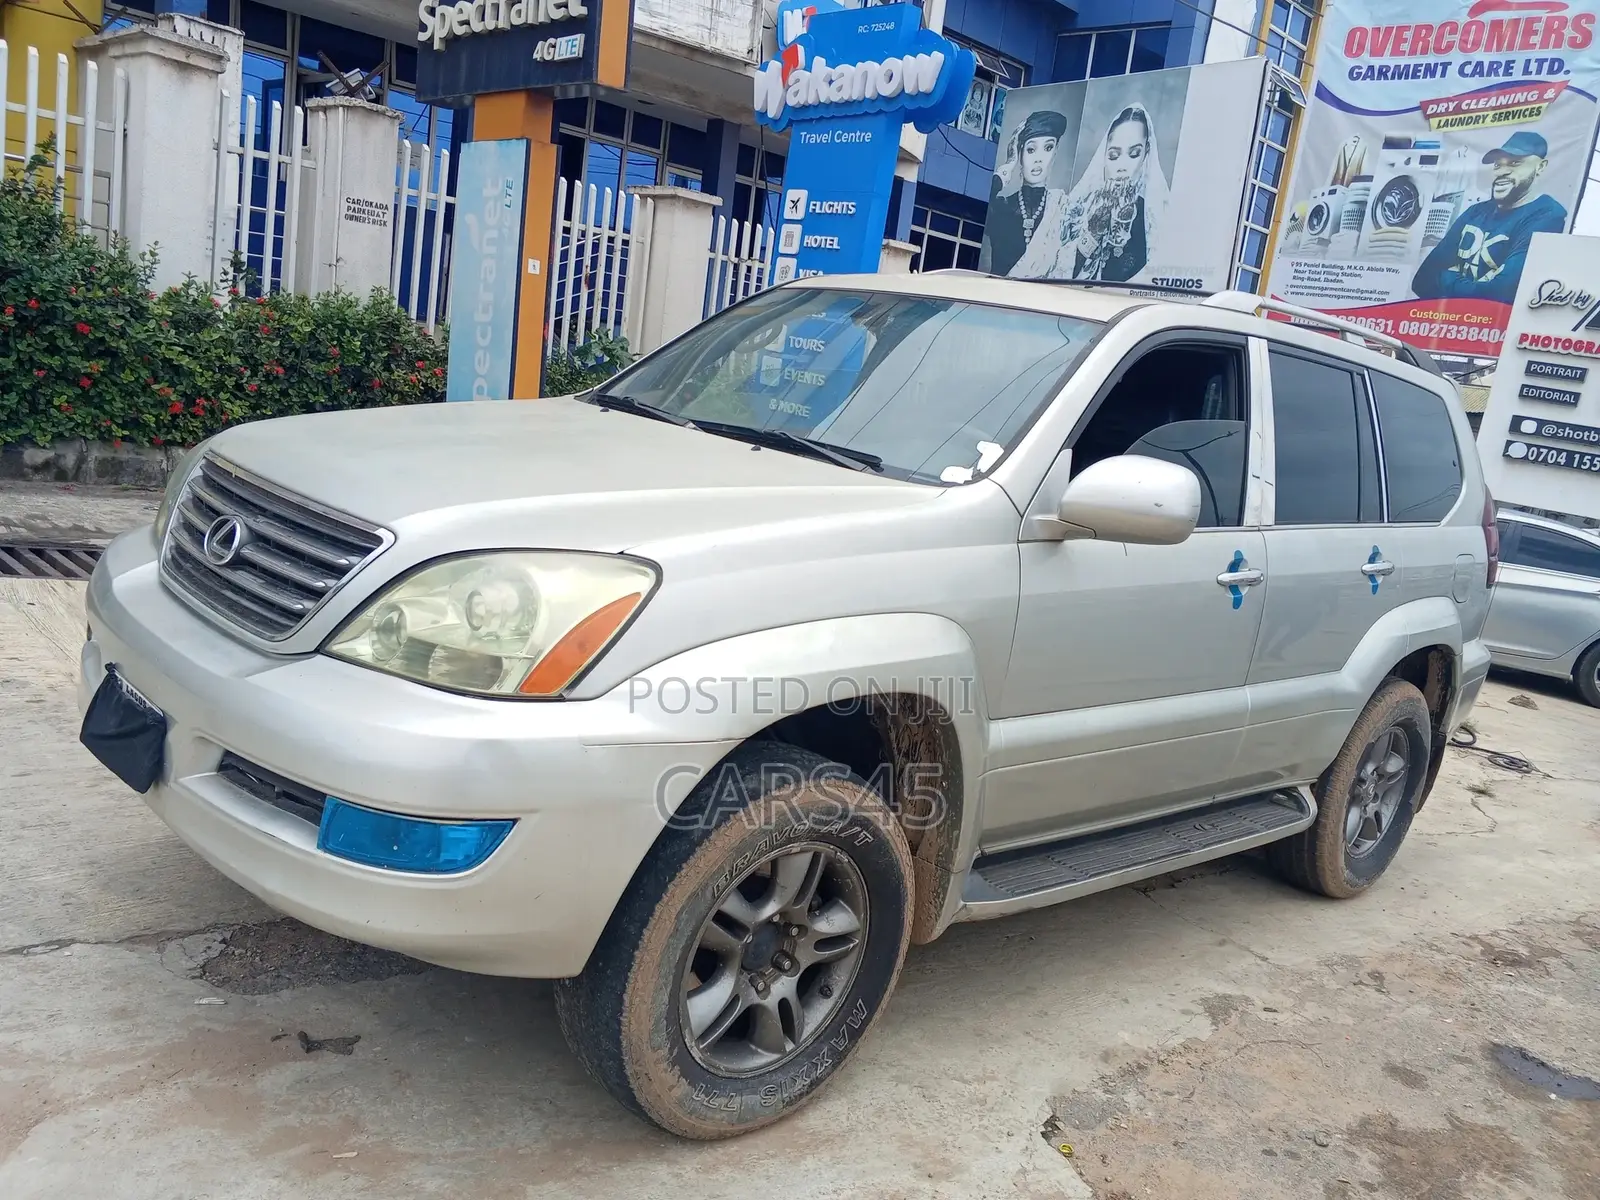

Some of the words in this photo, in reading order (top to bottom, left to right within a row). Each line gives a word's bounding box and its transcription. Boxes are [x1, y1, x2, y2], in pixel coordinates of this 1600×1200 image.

[857, 24, 870, 35] RC:
[871, 21, 895, 33] 725248
[1343, 13, 1596, 60] OVERCOMERS
[533, 37, 556, 61] 4G
[556, 36, 580, 58] LTE
[1348, 61, 1452, 82] GARMENT
[1457, 59, 1516, 79] CARE
[1521, 57, 1571, 77] LTD.
[754, 44, 945, 120] Wakanow
[1426, 100, 1459, 116] DRY
[1461, 90, 1540, 111] CLEANING
[1543, 87, 1556, 100] &
[1436, 113, 1489, 130] LAUNDRY
[1490, 105, 1543, 123] SERVICES
[800, 130, 831, 145] Travel
[834, 129, 872, 144] Centre
[345, 196, 389, 211] CAR/OKADA
[504, 179, 514, 209] LTE
[809, 201, 857, 215] FLIGHTS
[371, 217, 388, 227] RISK
[803, 235, 841, 249] HOTEL
[472, 175, 502, 400] pectranet
[1151, 277, 1204, 290] STUDIOS
[1409, 308, 1461, 322] Customer
[1463, 313, 1493, 324] Care:
[788, 335, 826, 353] TOURS
[783, 368, 827, 387] EVENTS
[1530, 363, 1583, 379] PORTRAIT
[1522, 387, 1577, 403] EDITORIAL
[768, 398, 778, 411] &
[777, 400, 812, 418] MORE
[1541, 424, 1600, 445] @shotb
[1528, 446, 1567, 466] 0704
[821, 819, 875, 847] A/T
[759, 998, 869, 1107] MAXXIS
